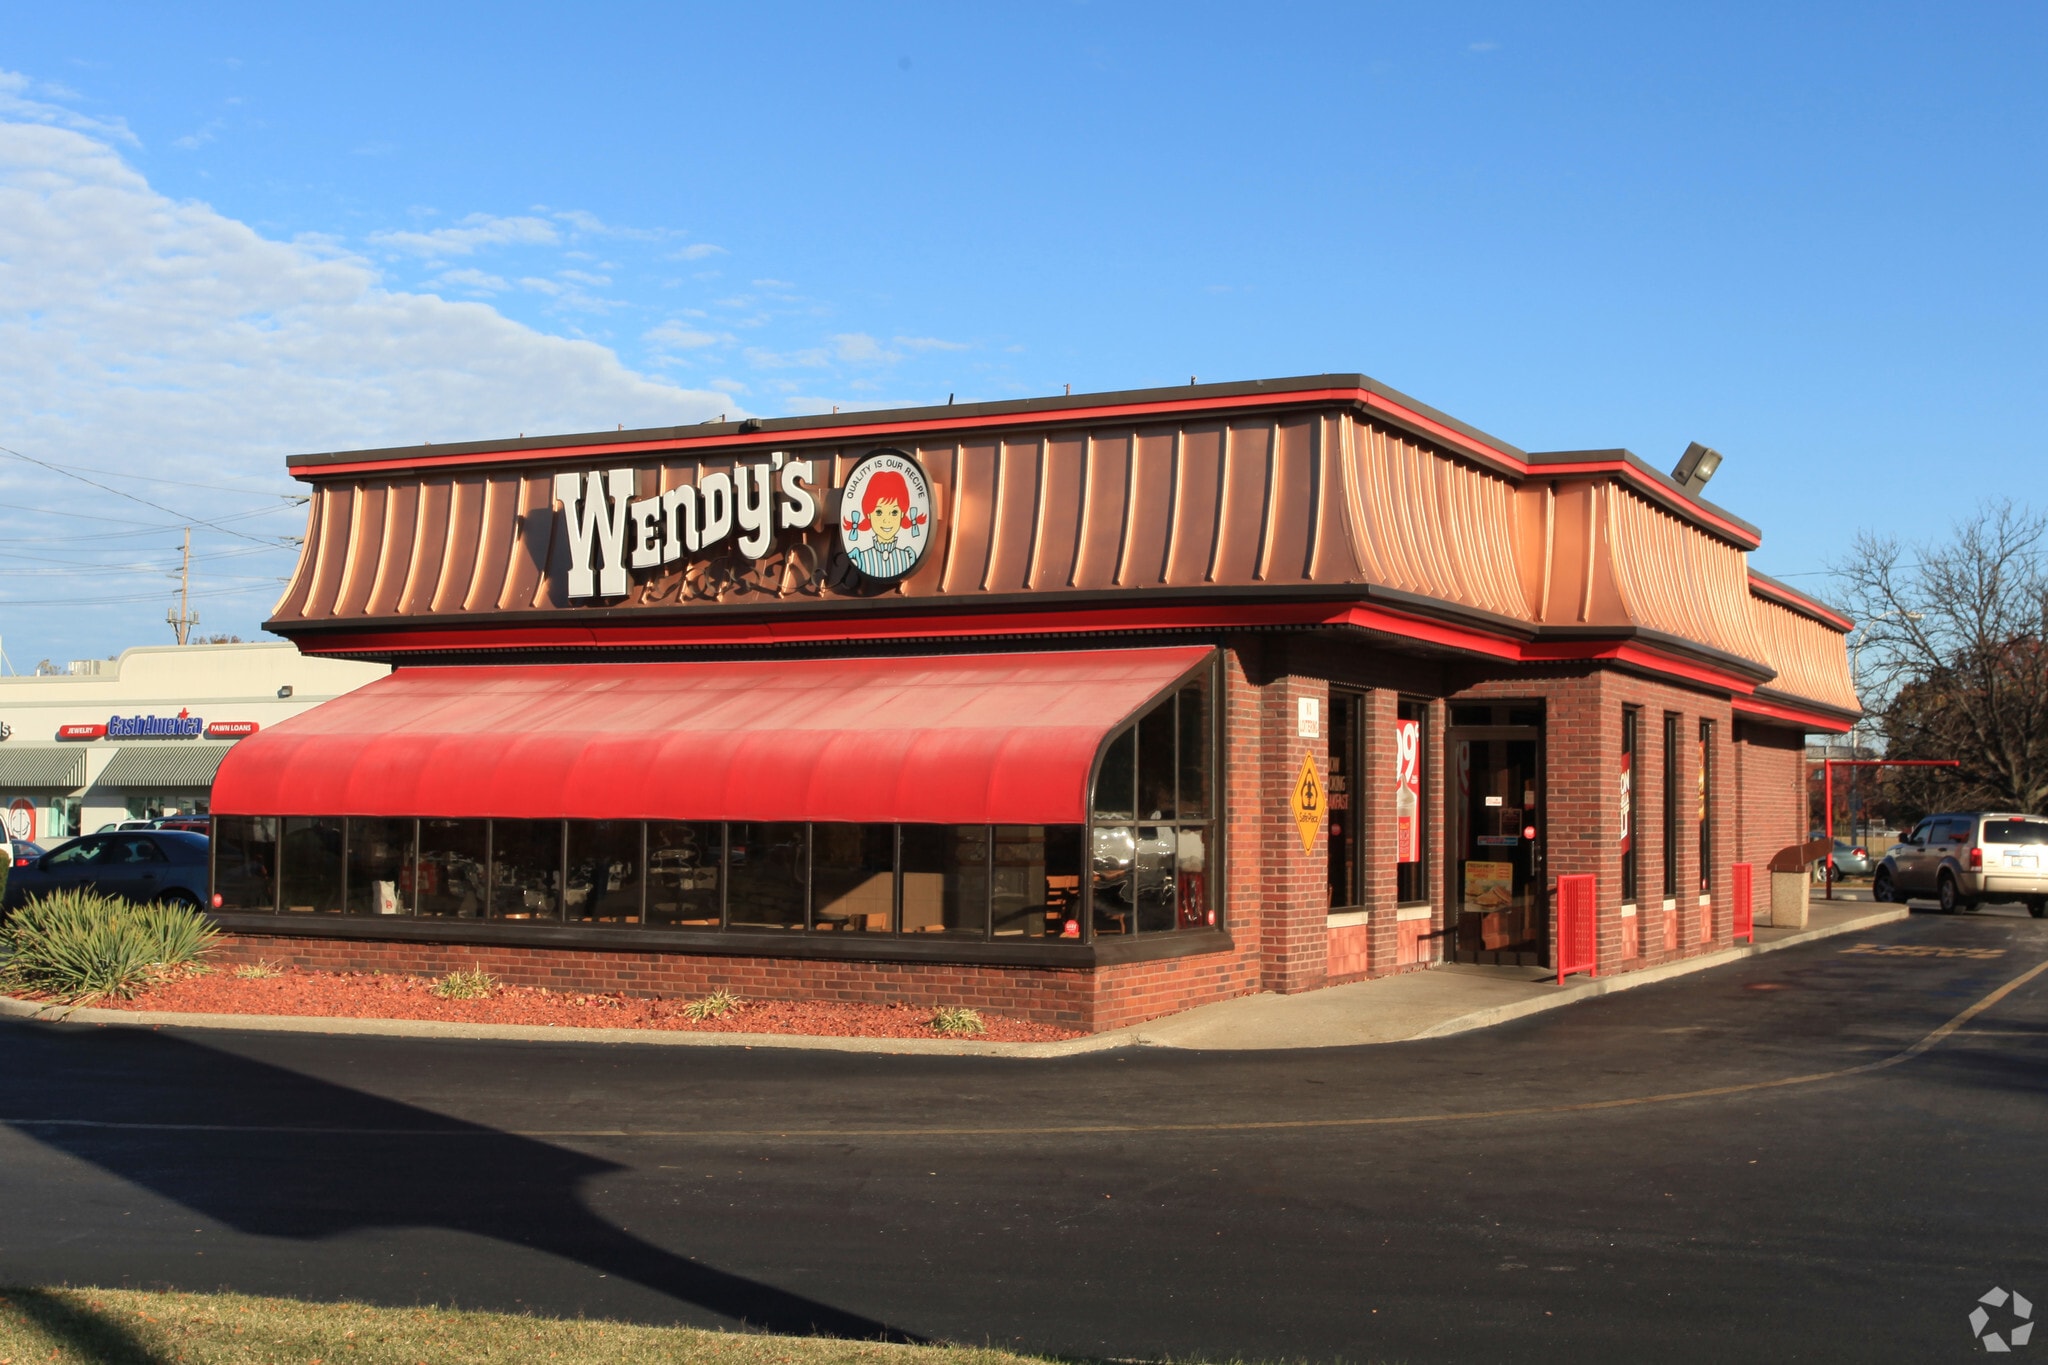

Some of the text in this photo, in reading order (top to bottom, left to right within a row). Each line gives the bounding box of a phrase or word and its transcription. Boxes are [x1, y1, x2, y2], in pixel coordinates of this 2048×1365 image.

[847, 459, 925, 499] QUALITY IS OUR RECIPE
[210, 723, 252, 732] PAWN LOANS
